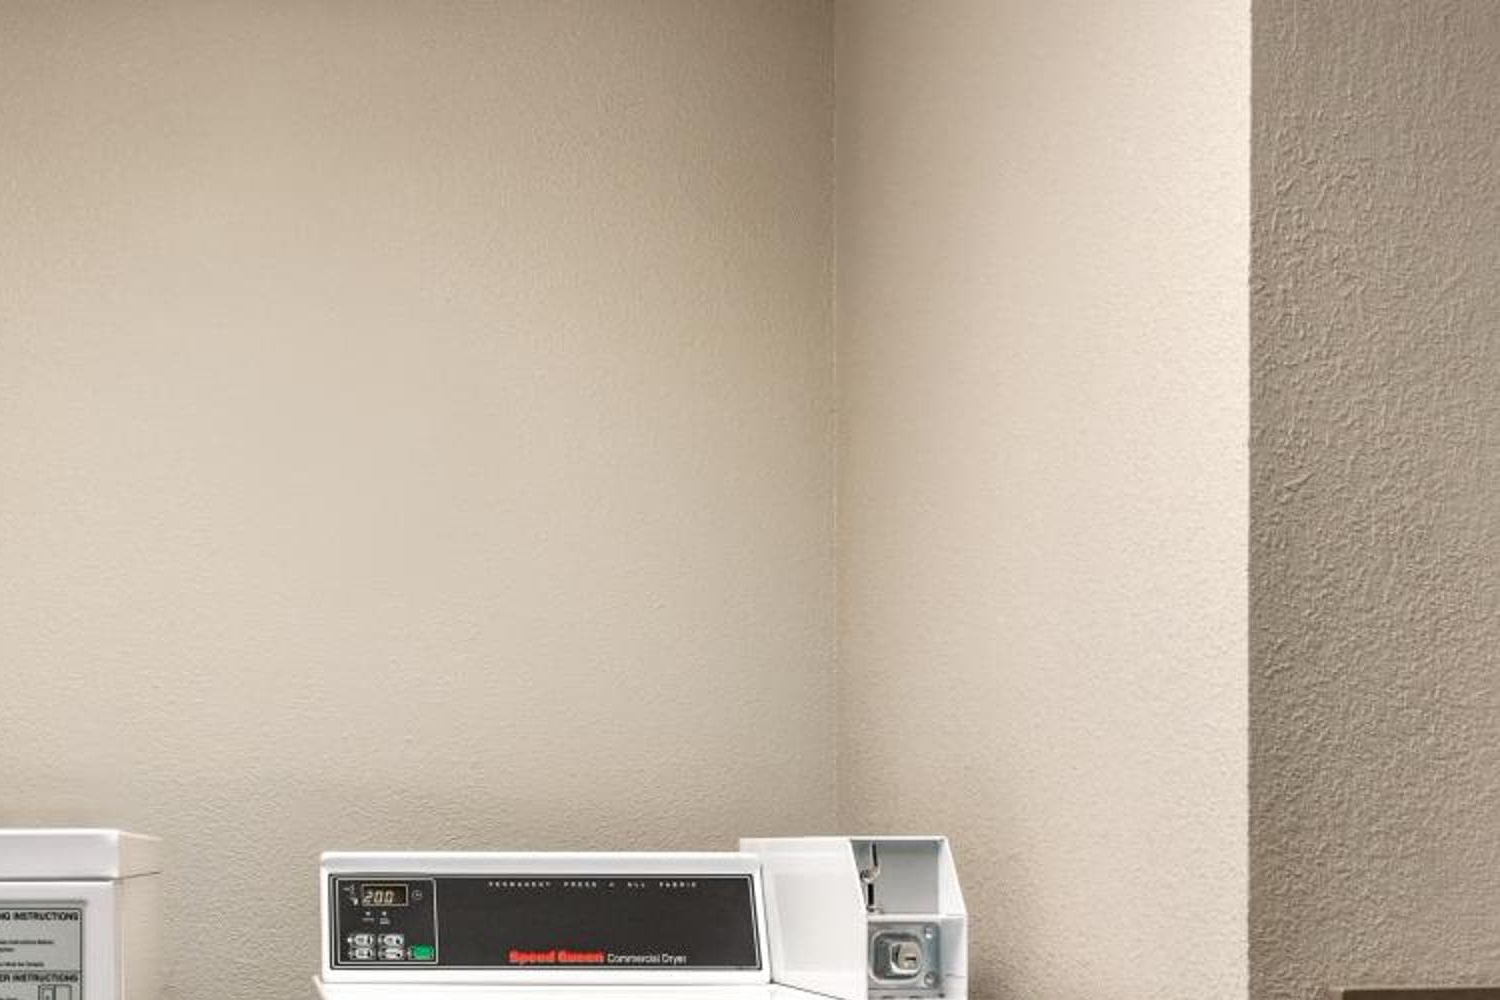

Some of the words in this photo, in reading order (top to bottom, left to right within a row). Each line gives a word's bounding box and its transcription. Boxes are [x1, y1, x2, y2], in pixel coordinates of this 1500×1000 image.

[361, 890, 394, 906] 200
[13, 911, 79, 921] INSTRUCTIONS
[509, 949, 556, 965] Speed
[557, 950, 605, 963] Queen
[607, 952, 660, 964] Commercial
[662, 952, 687, 965] Dryer
[12, 973, 79, 982] INSTRUCTIONS
